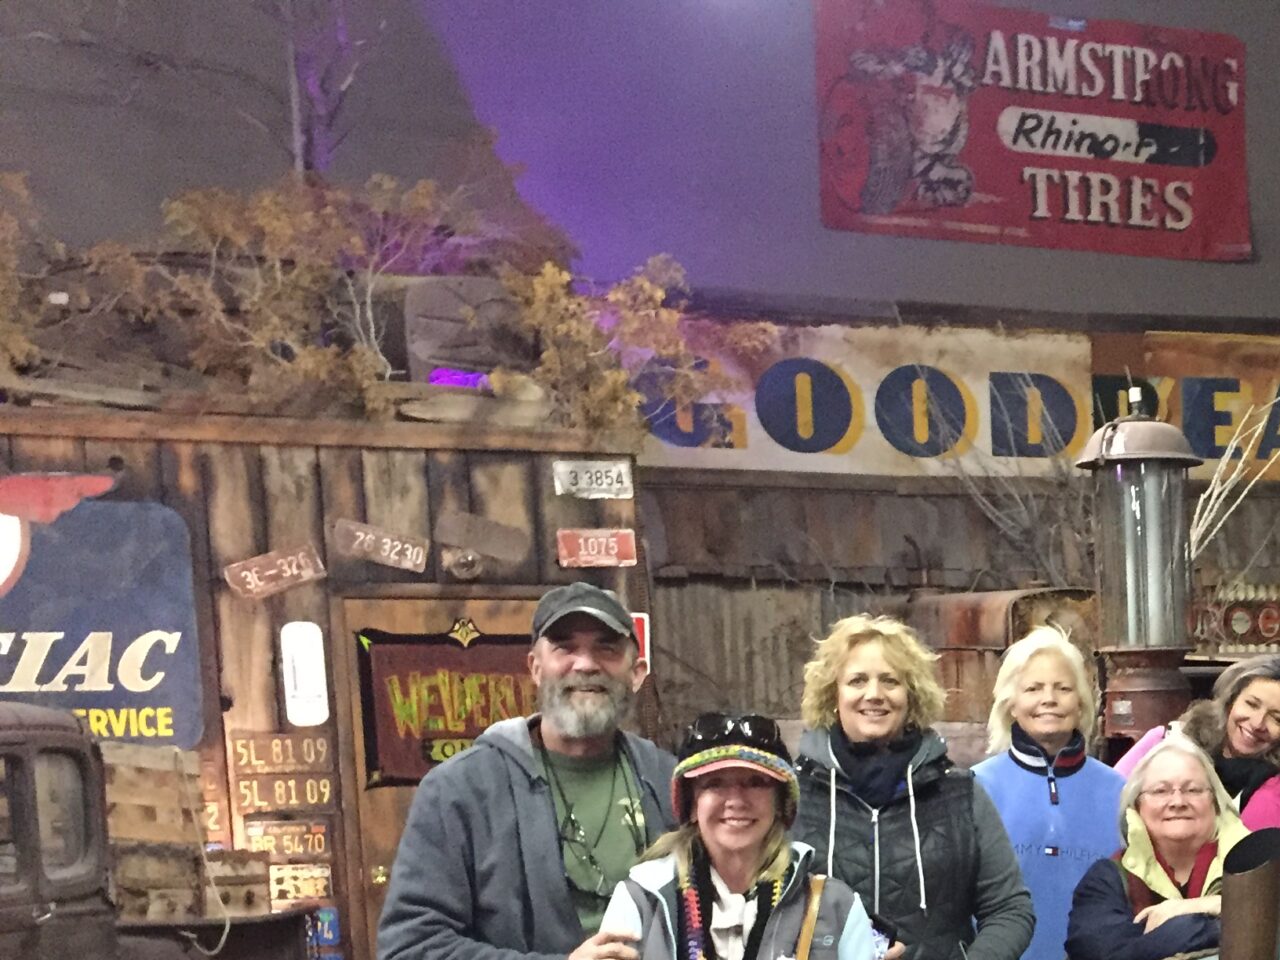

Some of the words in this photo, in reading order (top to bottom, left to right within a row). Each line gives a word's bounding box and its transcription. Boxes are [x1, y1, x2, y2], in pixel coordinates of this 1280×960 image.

[981, 29, 1239, 115] ARMSTRONG
[1022, 166, 1194, 231] TIRES
[584, 469, 625, 487] 3854
[578, 538, 619, 555] 1075
[71, 706, 175, 738] RVICE
[236, 738, 265, 766] 5L
[271, 738, 297, 765] 81
[302, 737, 328, 764] 09
[239, 779, 269, 807] 5L
[274, 779, 300, 805] 81
[306, 778, 331, 804] 09
